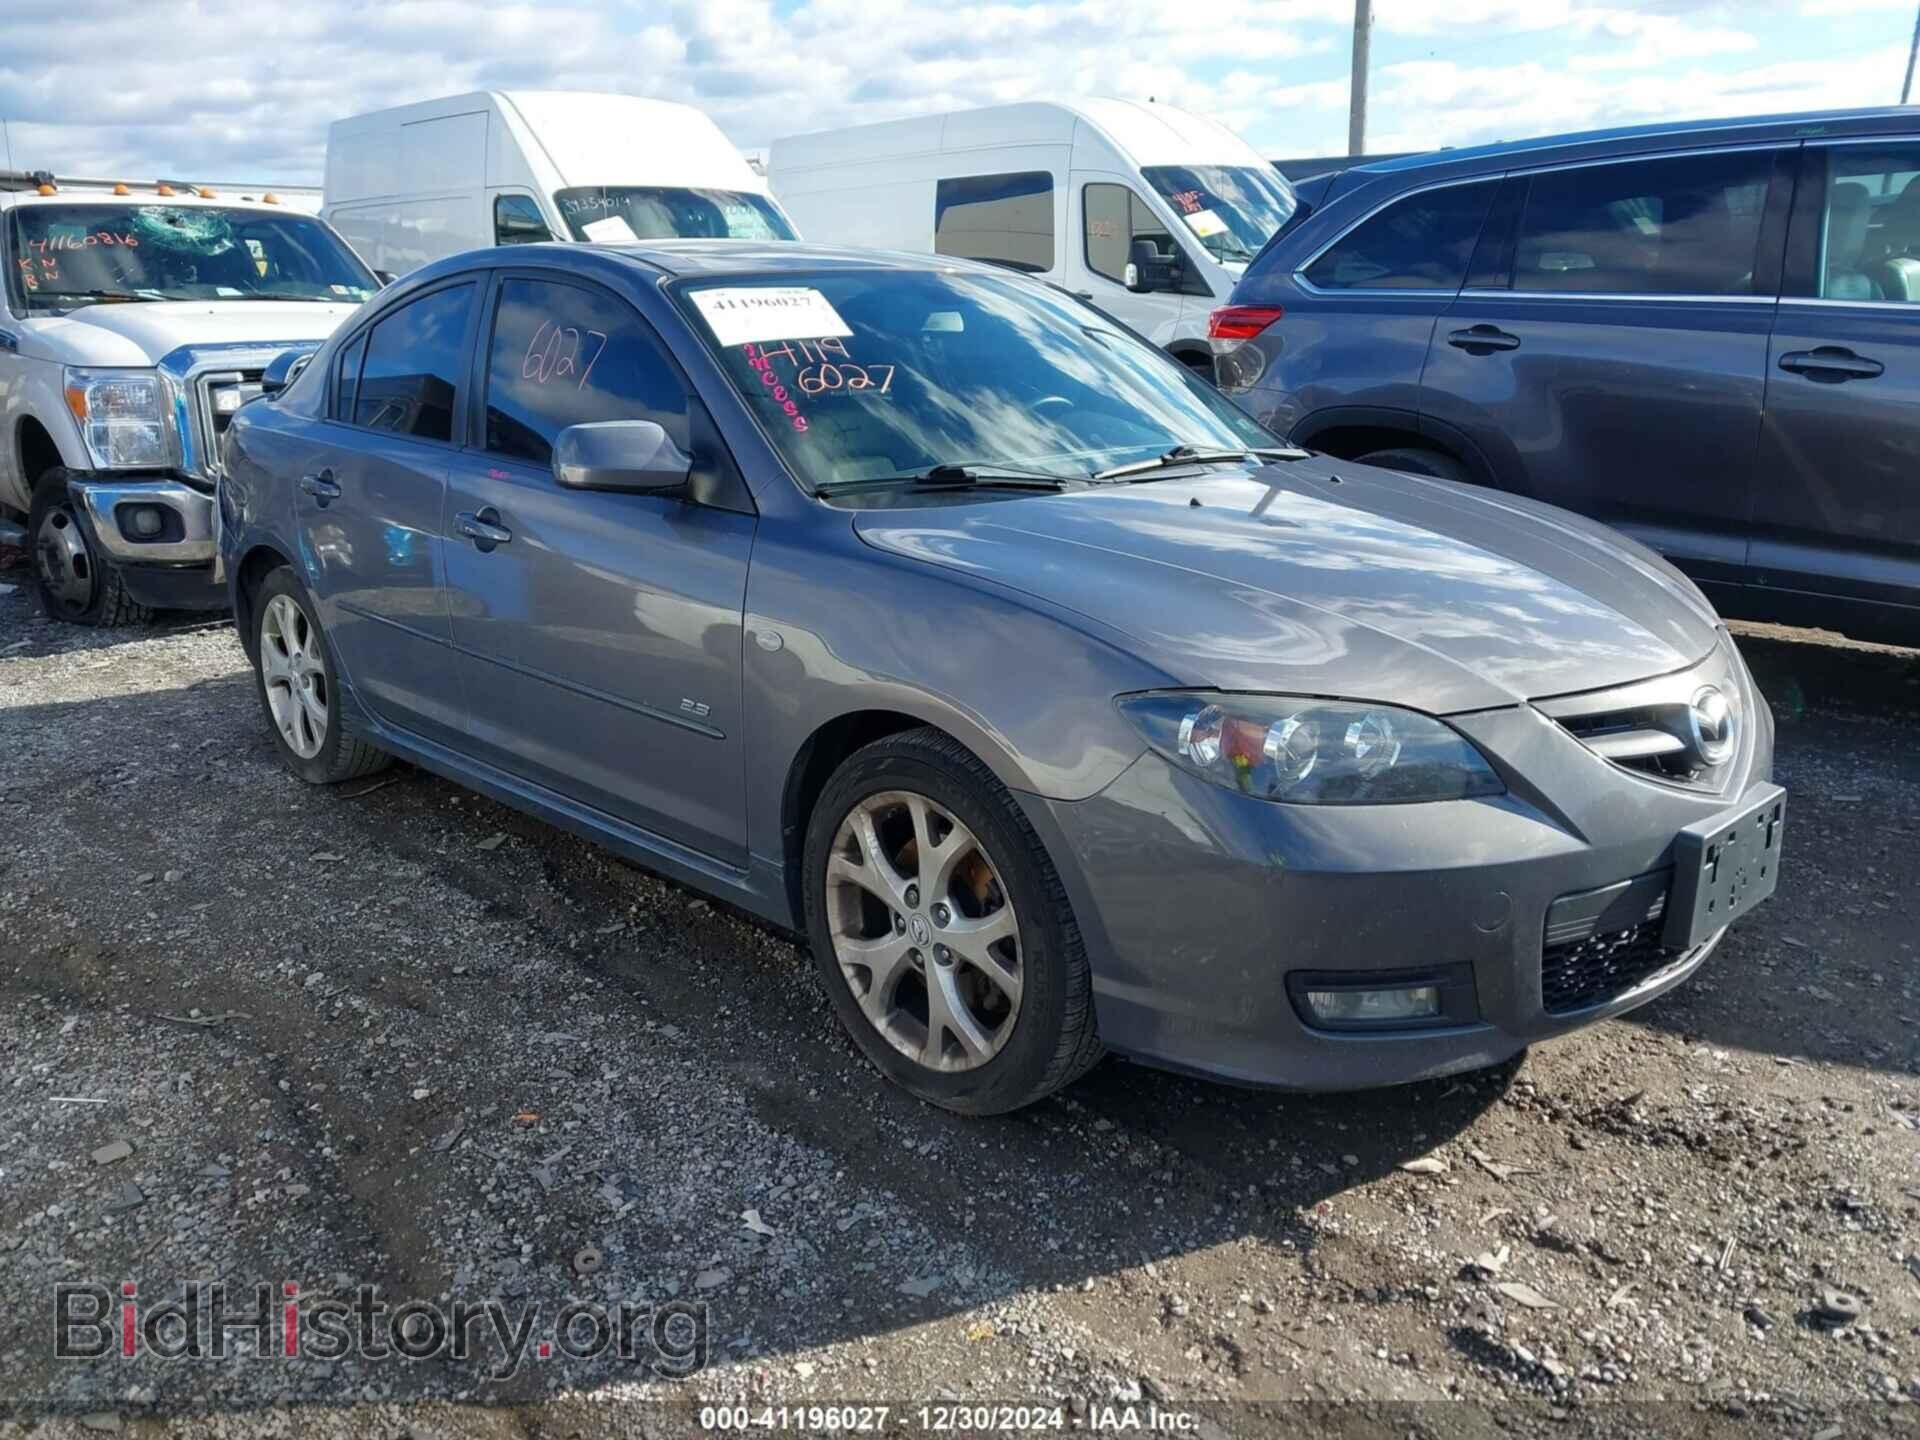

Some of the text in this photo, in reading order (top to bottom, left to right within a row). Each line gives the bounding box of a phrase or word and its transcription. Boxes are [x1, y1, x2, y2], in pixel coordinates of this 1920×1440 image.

[522, 319, 608, 391] 6027
[759, 337, 851, 366] 4119
[798, 363, 895, 394] 6027
